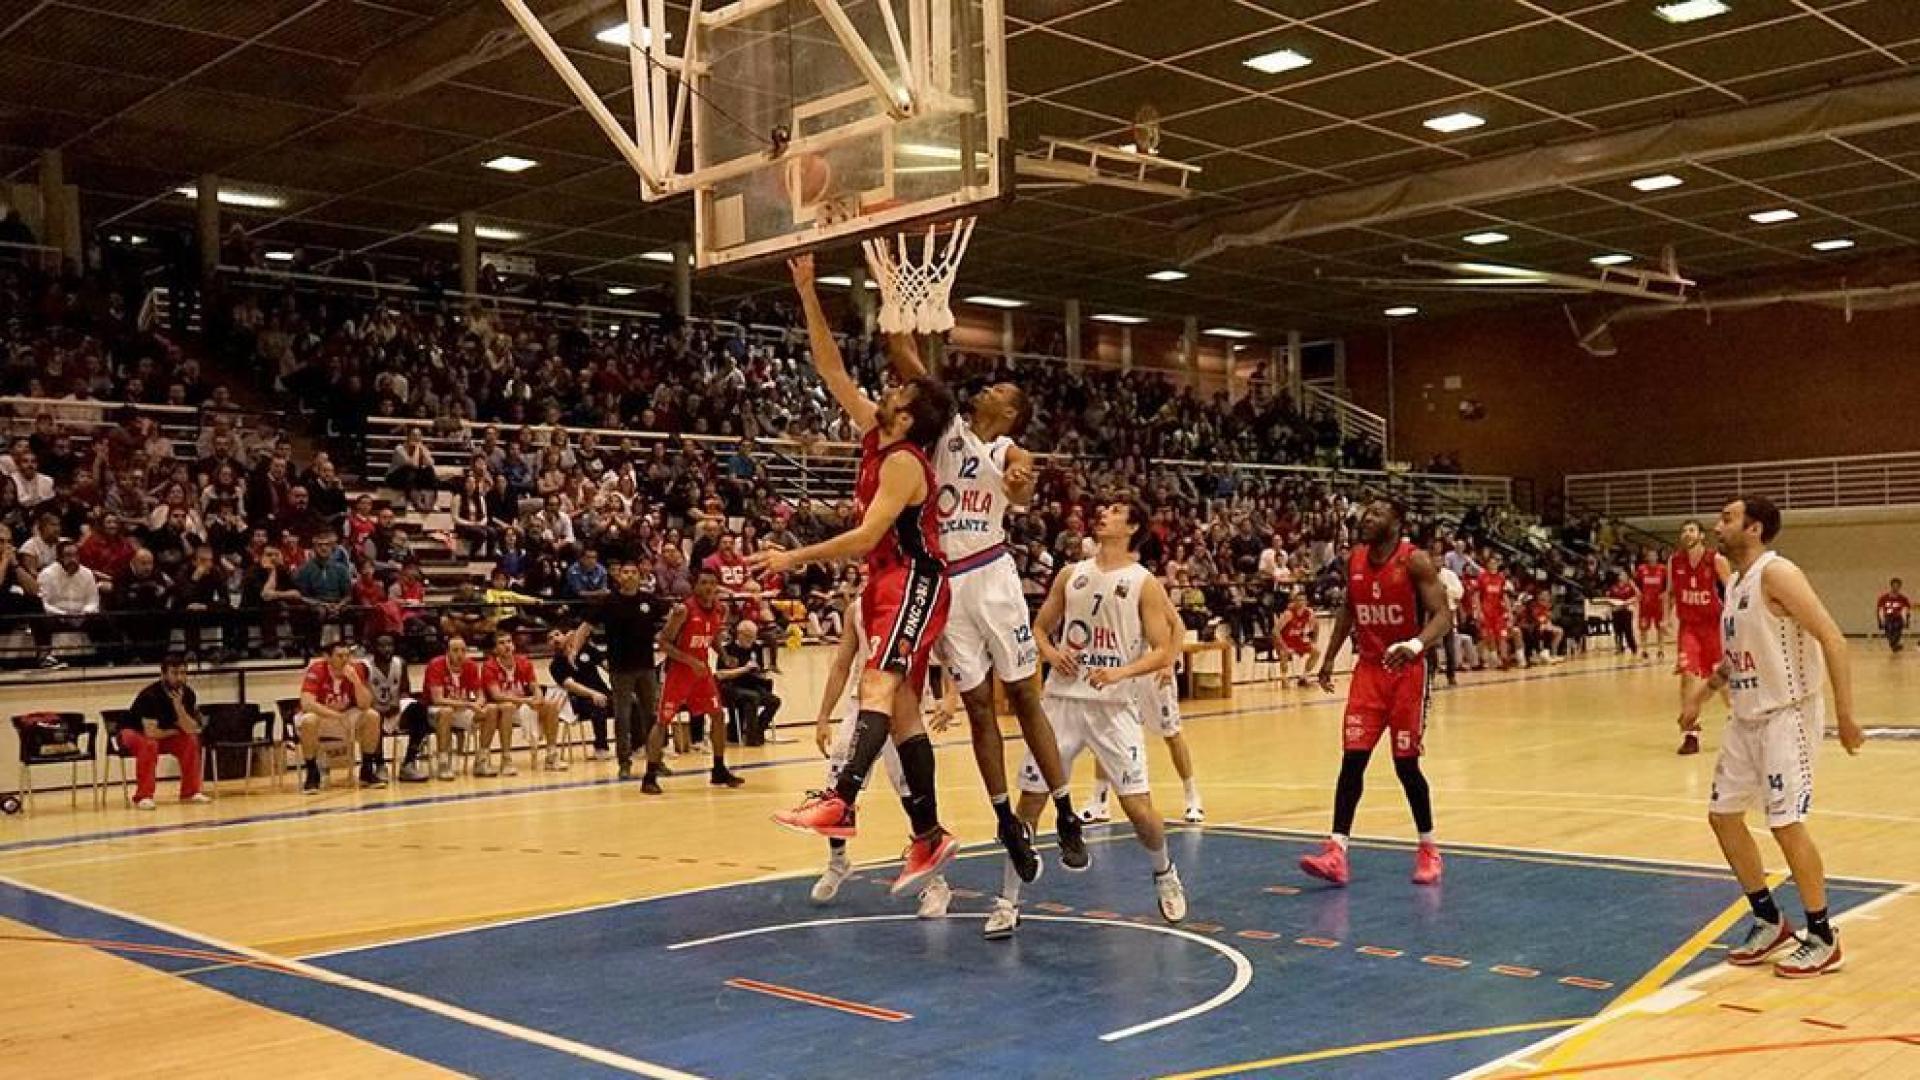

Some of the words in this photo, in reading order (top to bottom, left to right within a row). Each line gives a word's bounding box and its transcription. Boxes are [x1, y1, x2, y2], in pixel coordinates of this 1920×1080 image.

[958, 456, 979, 478] 12
[962, 490, 992, 513] HLA
[1092, 593, 1102, 616] 7
[1357, 604, 1403, 624] BNC
[1014, 624, 1032, 643] 12
[1397, 730, 1411, 750] 5
[1768, 773, 1784, 791] 14
